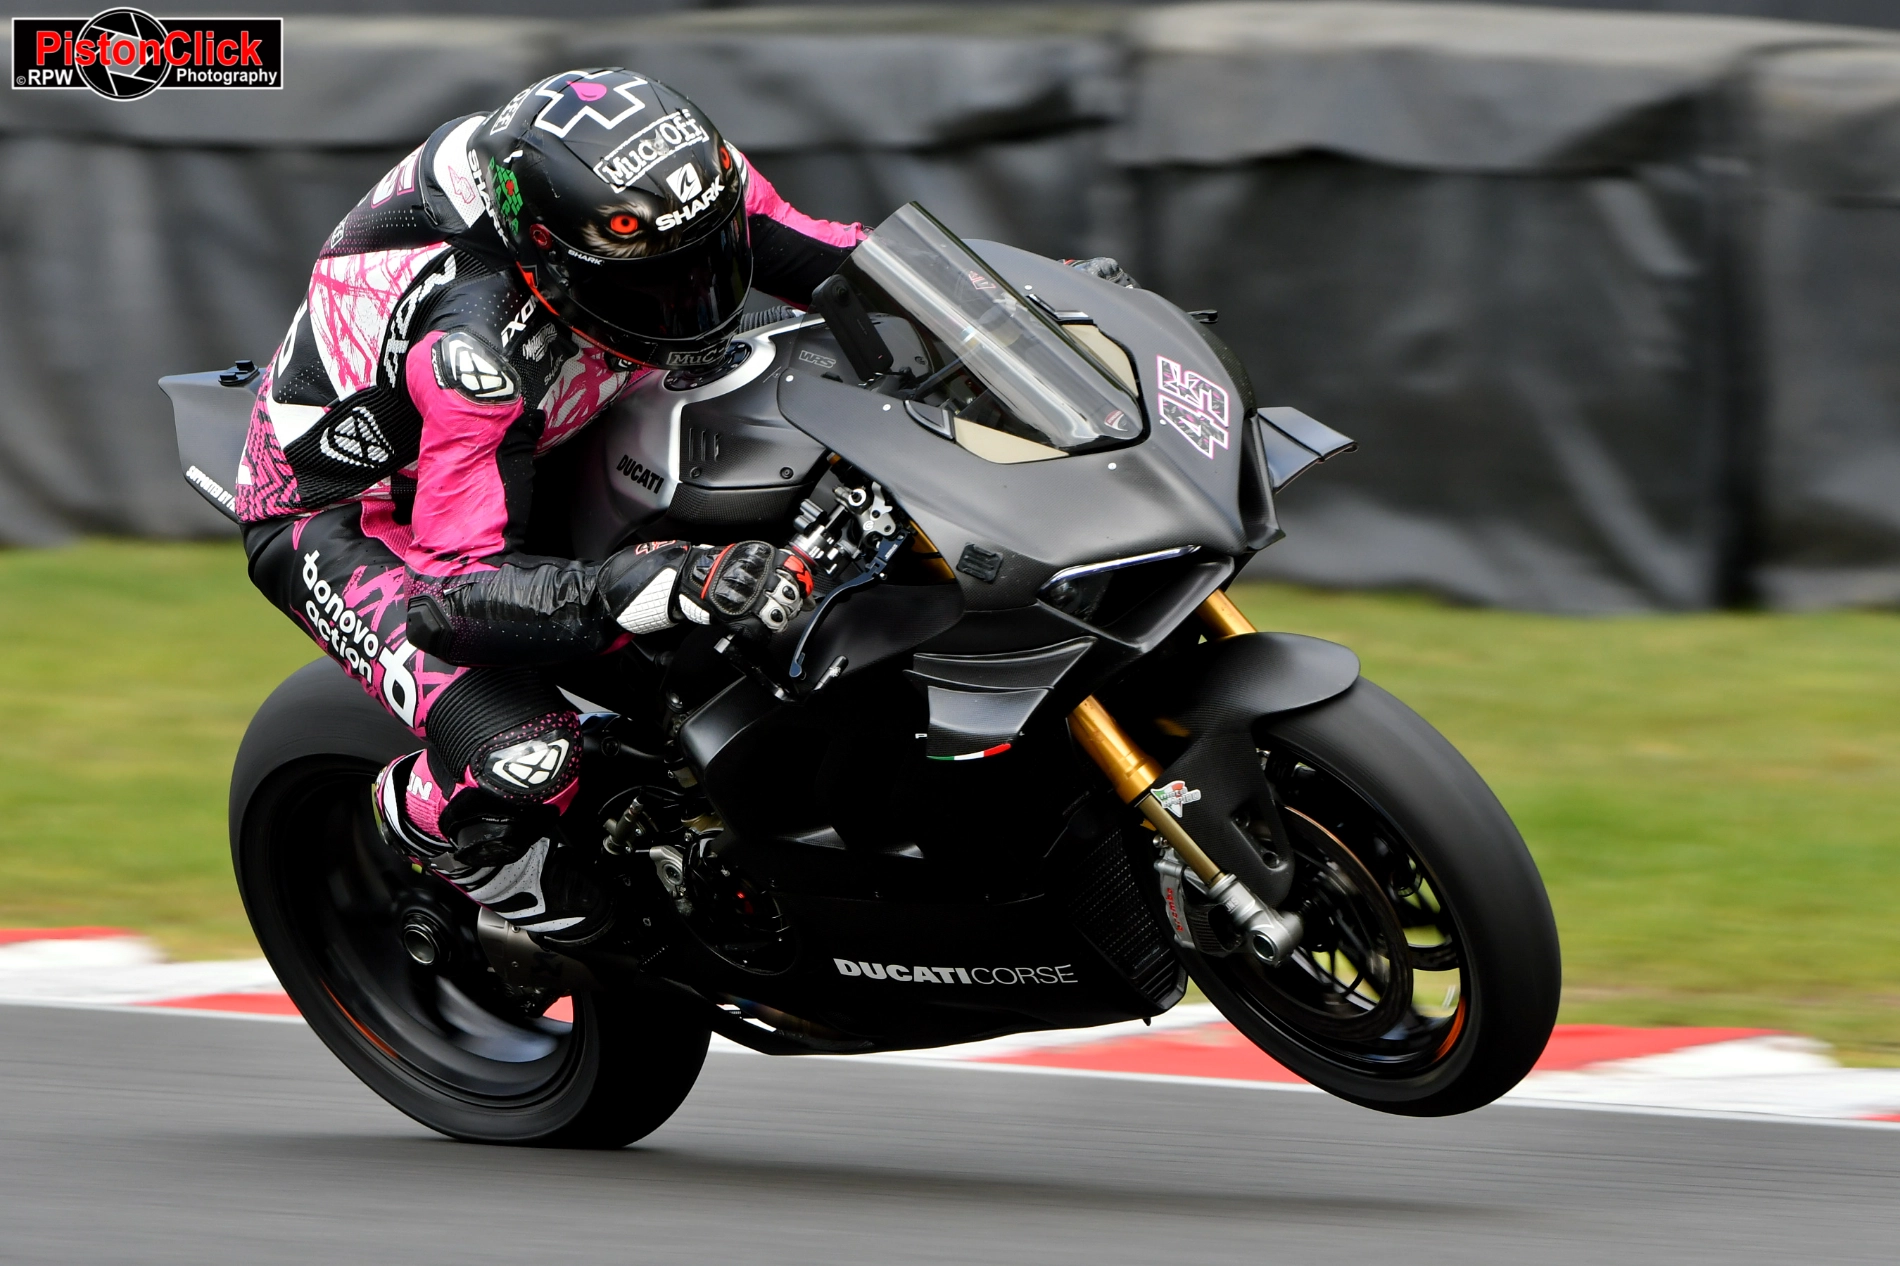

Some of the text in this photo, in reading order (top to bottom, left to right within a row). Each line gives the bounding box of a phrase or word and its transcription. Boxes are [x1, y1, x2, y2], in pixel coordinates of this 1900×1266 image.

[655, 175, 725, 232] SHARK
[567, 249, 603, 265] SHARK
[799, 349, 837, 369] WRS
[1156, 353, 1230, 461] 45
[615, 453, 666, 495] DUCATI
[302, 549, 380, 658] bonovo
[305, 600, 373, 684] action
[1166, 887, 1185, 932] brembo
